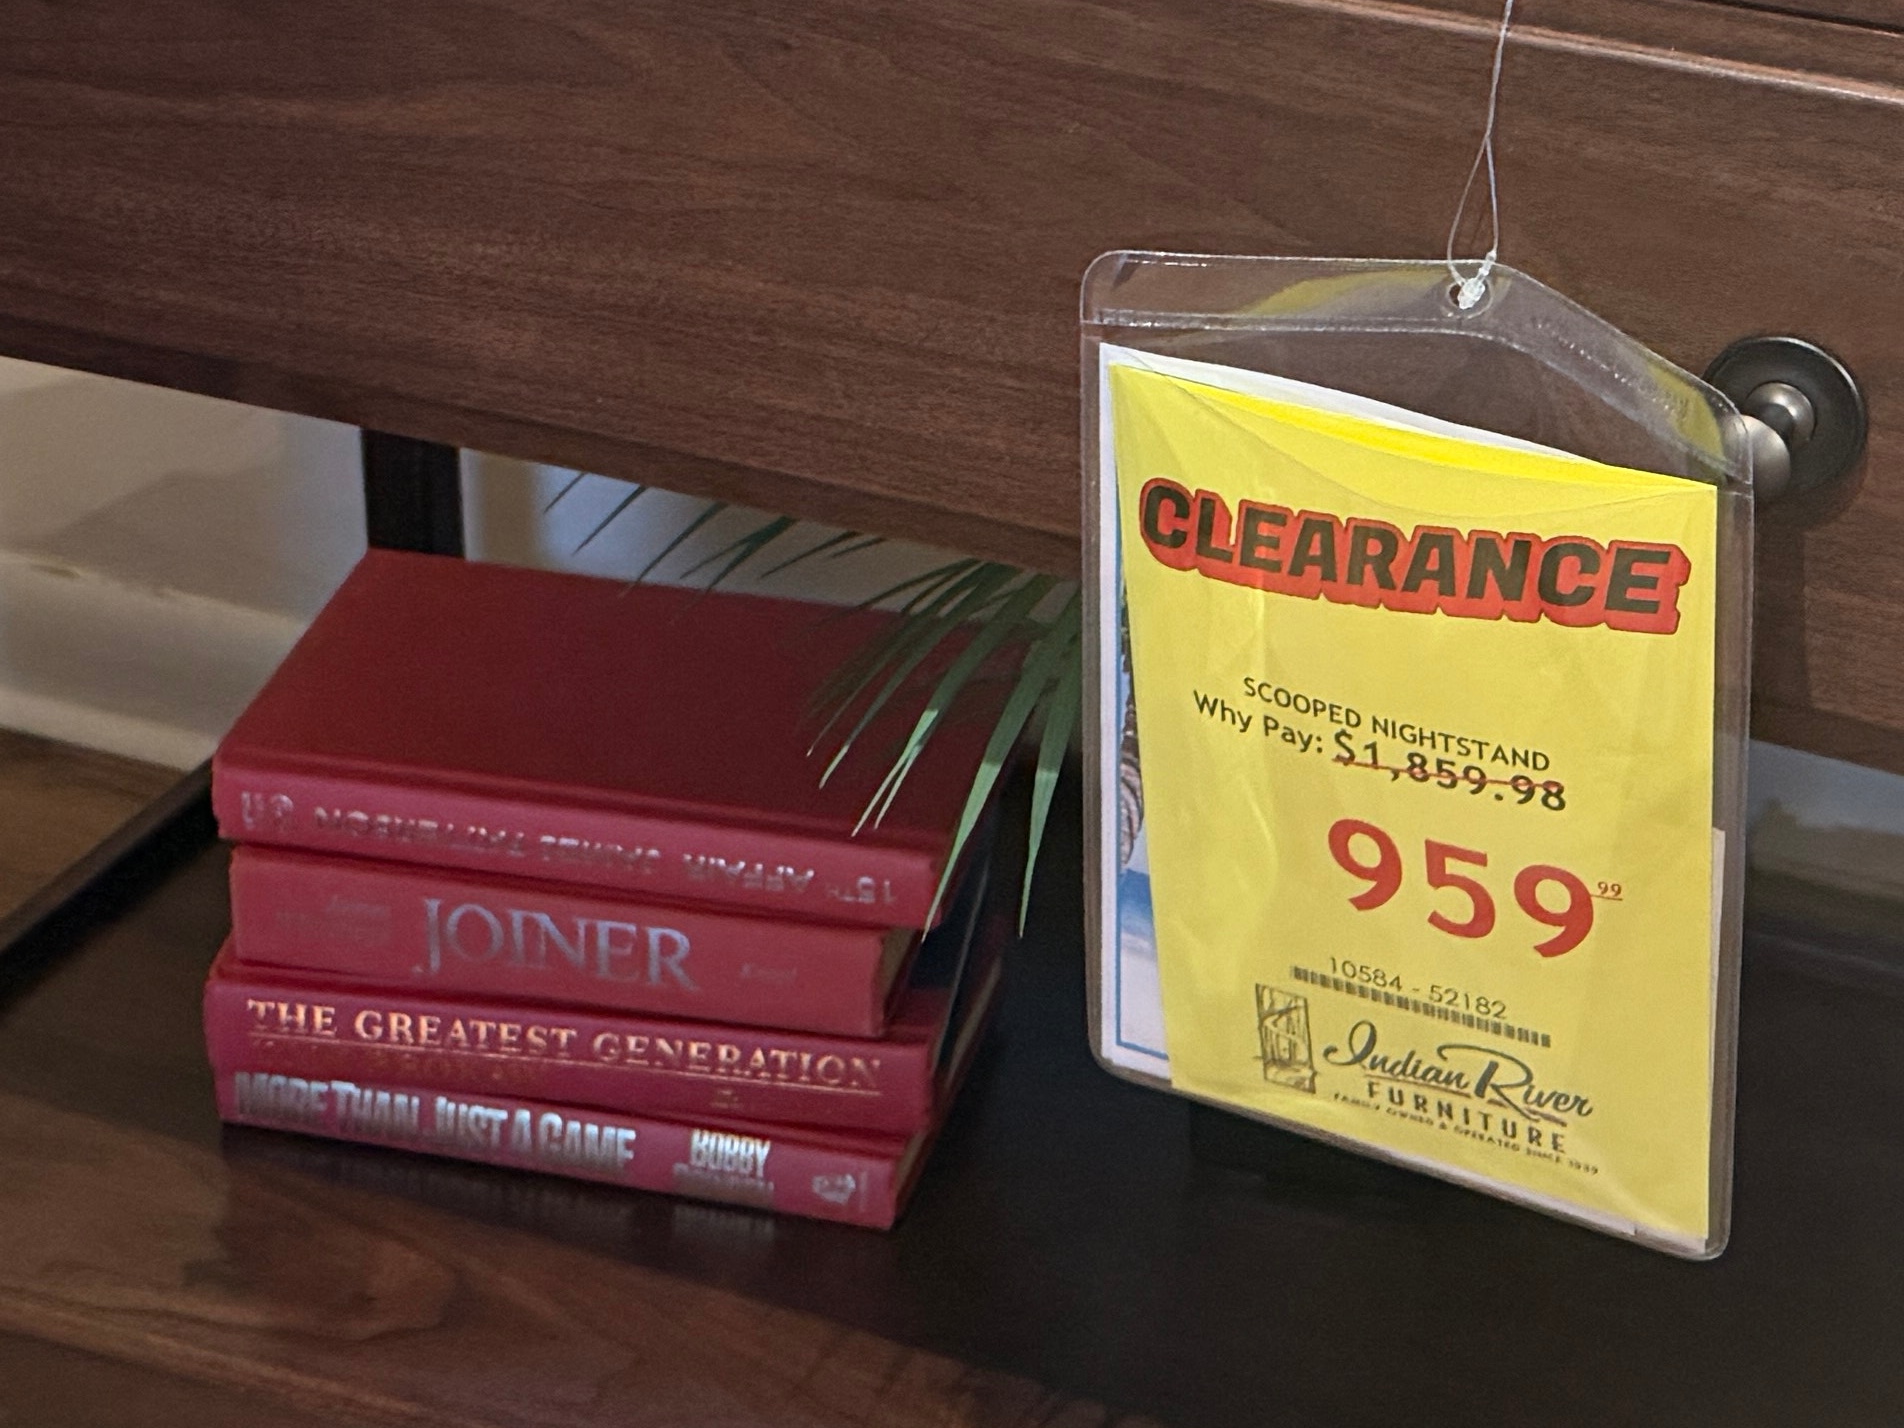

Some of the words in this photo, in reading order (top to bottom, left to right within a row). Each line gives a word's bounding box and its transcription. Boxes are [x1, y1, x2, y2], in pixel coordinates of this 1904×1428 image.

[1140, 480, 1680, 624] CLEARANCE
[1193, 690, 1252, 733] Why
[1263, 715, 1323, 754] Pay:
[1332, 728, 1567, 811] $1,859.98
[1243, 677, 1361, 728] SCOOPED
[1372, 715, 1550, 771] NIGHTSTAND
[683, 854, 815, 891] AFFAIR
[1328, 819, 1594, 958] 959
[1597, 881, 1623, 900] 99
[411, 898, 698, 991] JOINER
[1330, 957, 1402, 992] 10584
[1428, 984, 1507, 1019] 52182
[248, 999, 337, 1038] THE
[354, 1009, 578, 1058] GREATEST
[593, 1033, 881, 1088] GENERATION
[1323, 1020, 1471, 1090] Indian
[1437, 1043, 1593, 1122] River
[234, 1072, 329, 1125] MORE
[330, 1080, 420, 1139] THAN
[428, 1096, 509, 1150] JUST
[510, 1108, 533, 1155] A
[537, 1112, 636, 1170] GAME
[690, 1128, 772, 1177] BOBBY
[1367, 1080, 1566, 1154] FURNITURE
[1386, 1106, 1434, 1126] OWNED
[1454, 1124, 1520, 1152] OPERATED
